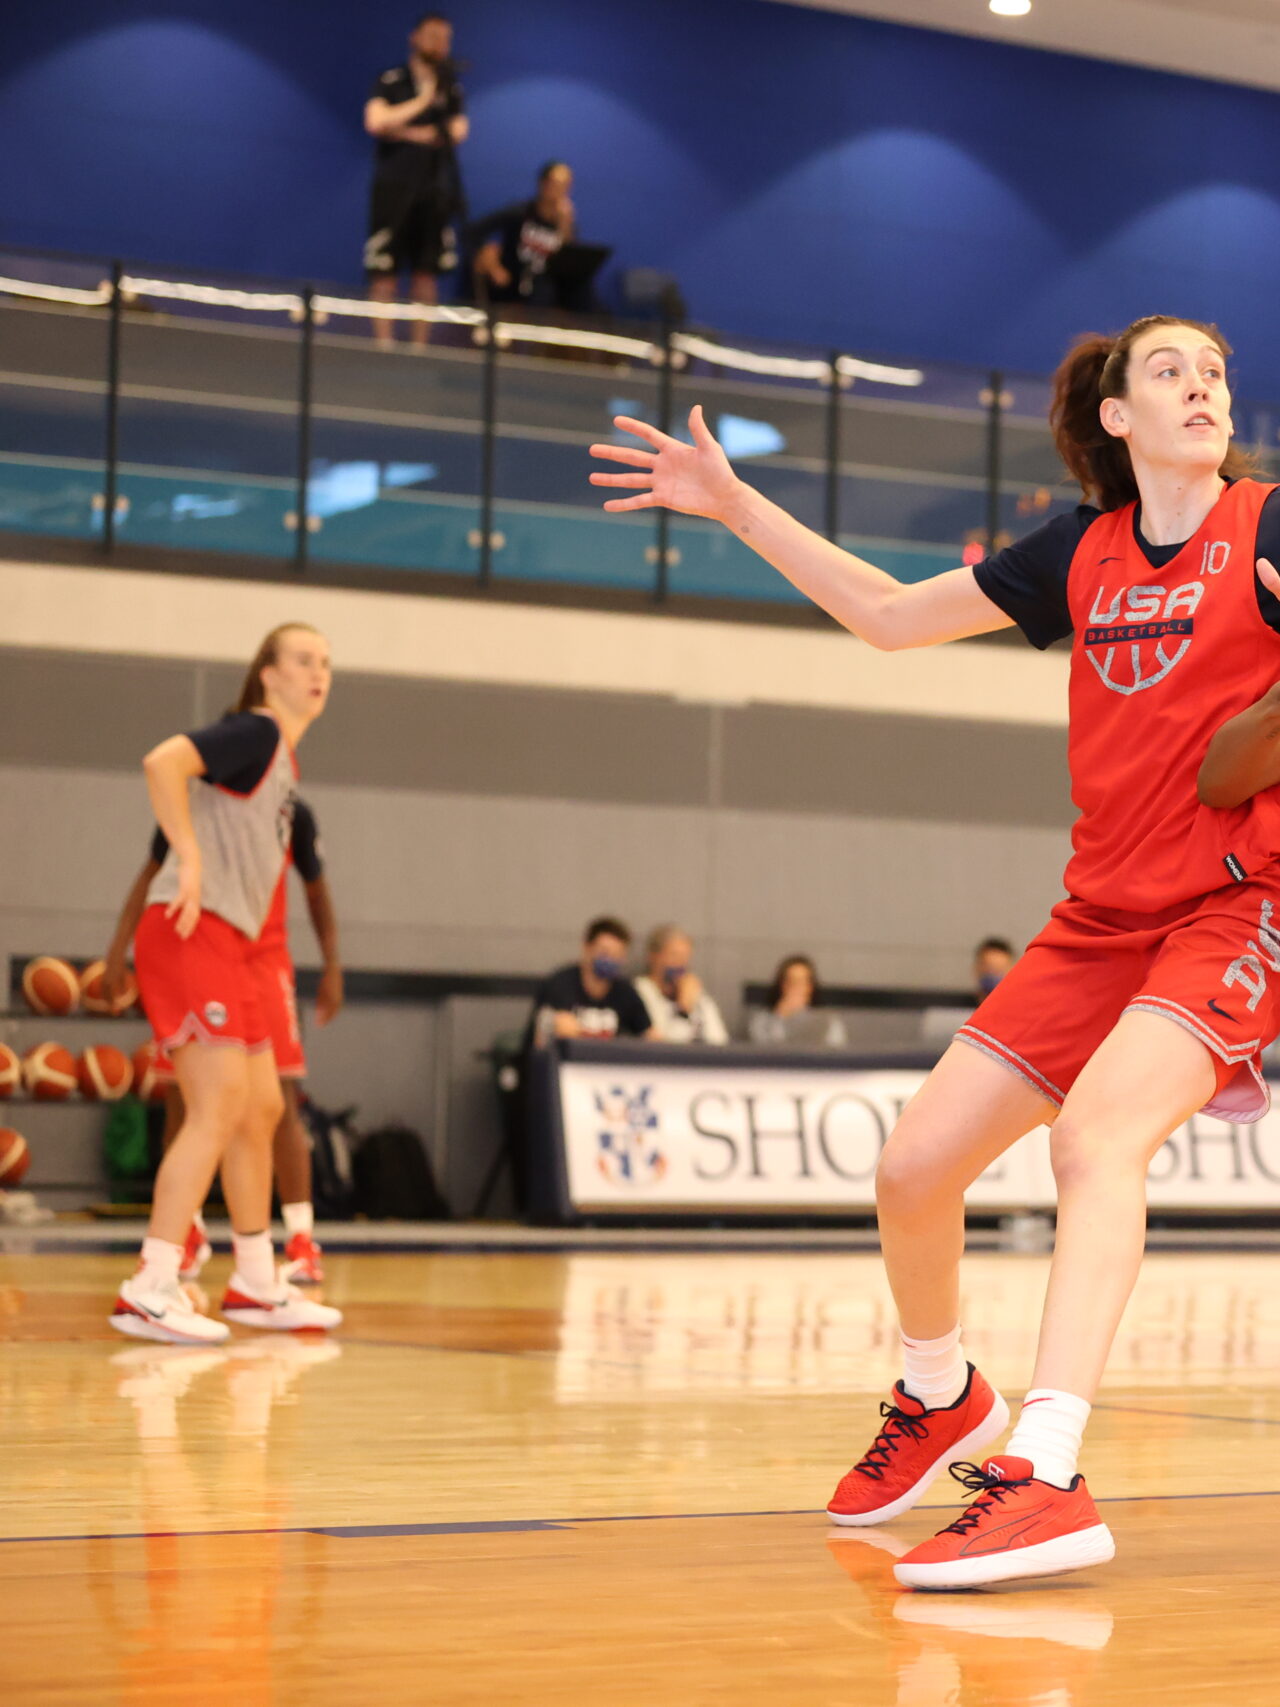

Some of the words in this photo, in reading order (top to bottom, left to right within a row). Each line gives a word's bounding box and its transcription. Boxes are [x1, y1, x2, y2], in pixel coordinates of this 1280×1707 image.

[1199, 541, 1231, 575] 10
[1088, 581, 1205, 624] USA
[1087, 622, 1186, 642] BASKETBALL
[688, 1088, 1007, 1184] SHO
